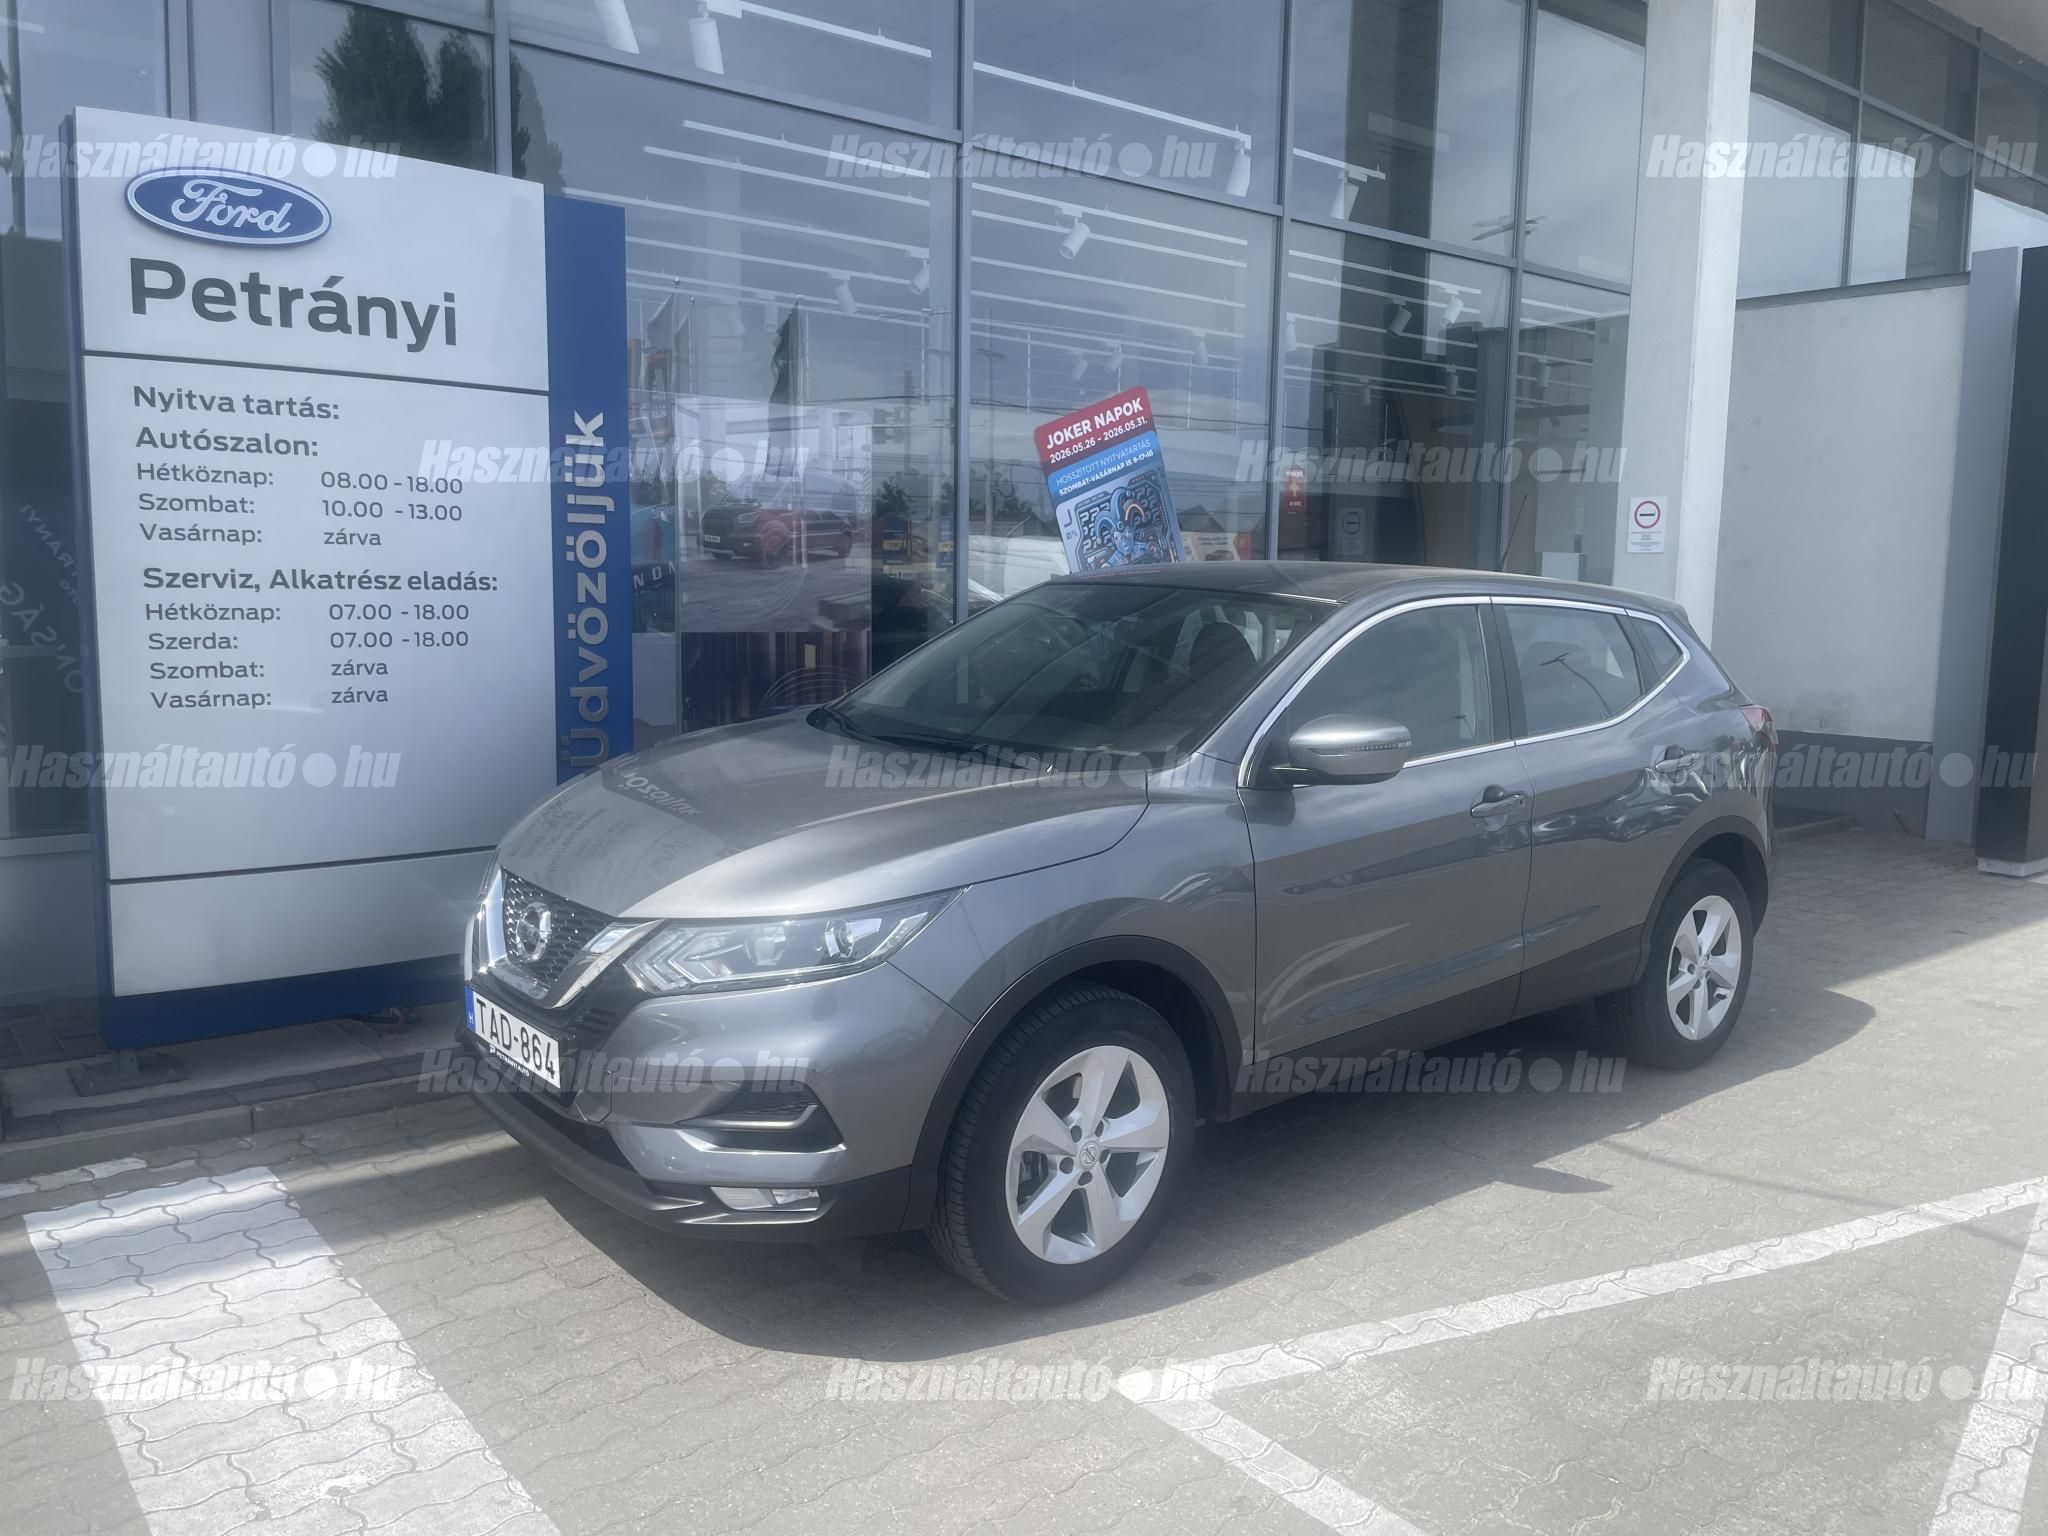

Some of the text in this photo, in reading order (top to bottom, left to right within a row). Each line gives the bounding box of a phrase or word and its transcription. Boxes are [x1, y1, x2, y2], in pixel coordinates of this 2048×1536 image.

[171, 179, 293, 233] Ford
[130, 257, 458, 353] Petrányi
[133, 385, 340, 420] Nyitva tartás:
[1047, 398, 1144, 449] JOKER NAPOK
[135, 426, 319, 457] Autószalon:
[1050, 437, 1096, 463] 2026.05.26
[1103, 416, 1148, 441] 2026.05.31.
[1100, 438, 1151, 467] NYITVATARTÁS
[136, 462, 274, 489] Hétköznap:
[320, 471, 389, 491] 08.00
[406, 474, 464, 495] 18.00
[138, 492, 255, 514] Szombat:
[321, 499, 384, 519] 10.00
[407, 503, 463, 522] 13.00
[138, 522, 383, 547] Vasárnap: zárva
[142, 567, 498, 594] Szerviz, Alkatrész eladás:
[561, 410, 615, 768] Üdvözöljük
[144, 602, 281, 624] Hétköznap:
[328, 603, 392, 621] 07.00
[413, 603, 470, 621] 18.00
[147, 631, 239, 651] Szerda:
[329, 631, 393, 649] 07.00
[413, 630, 469, 648] 18.00
[149, 658, 389, 680] Szombat: zárva
[149, 686, 389, 710] Vasárnap: zárva
[476, 998, 556, 1080] TAD-864
